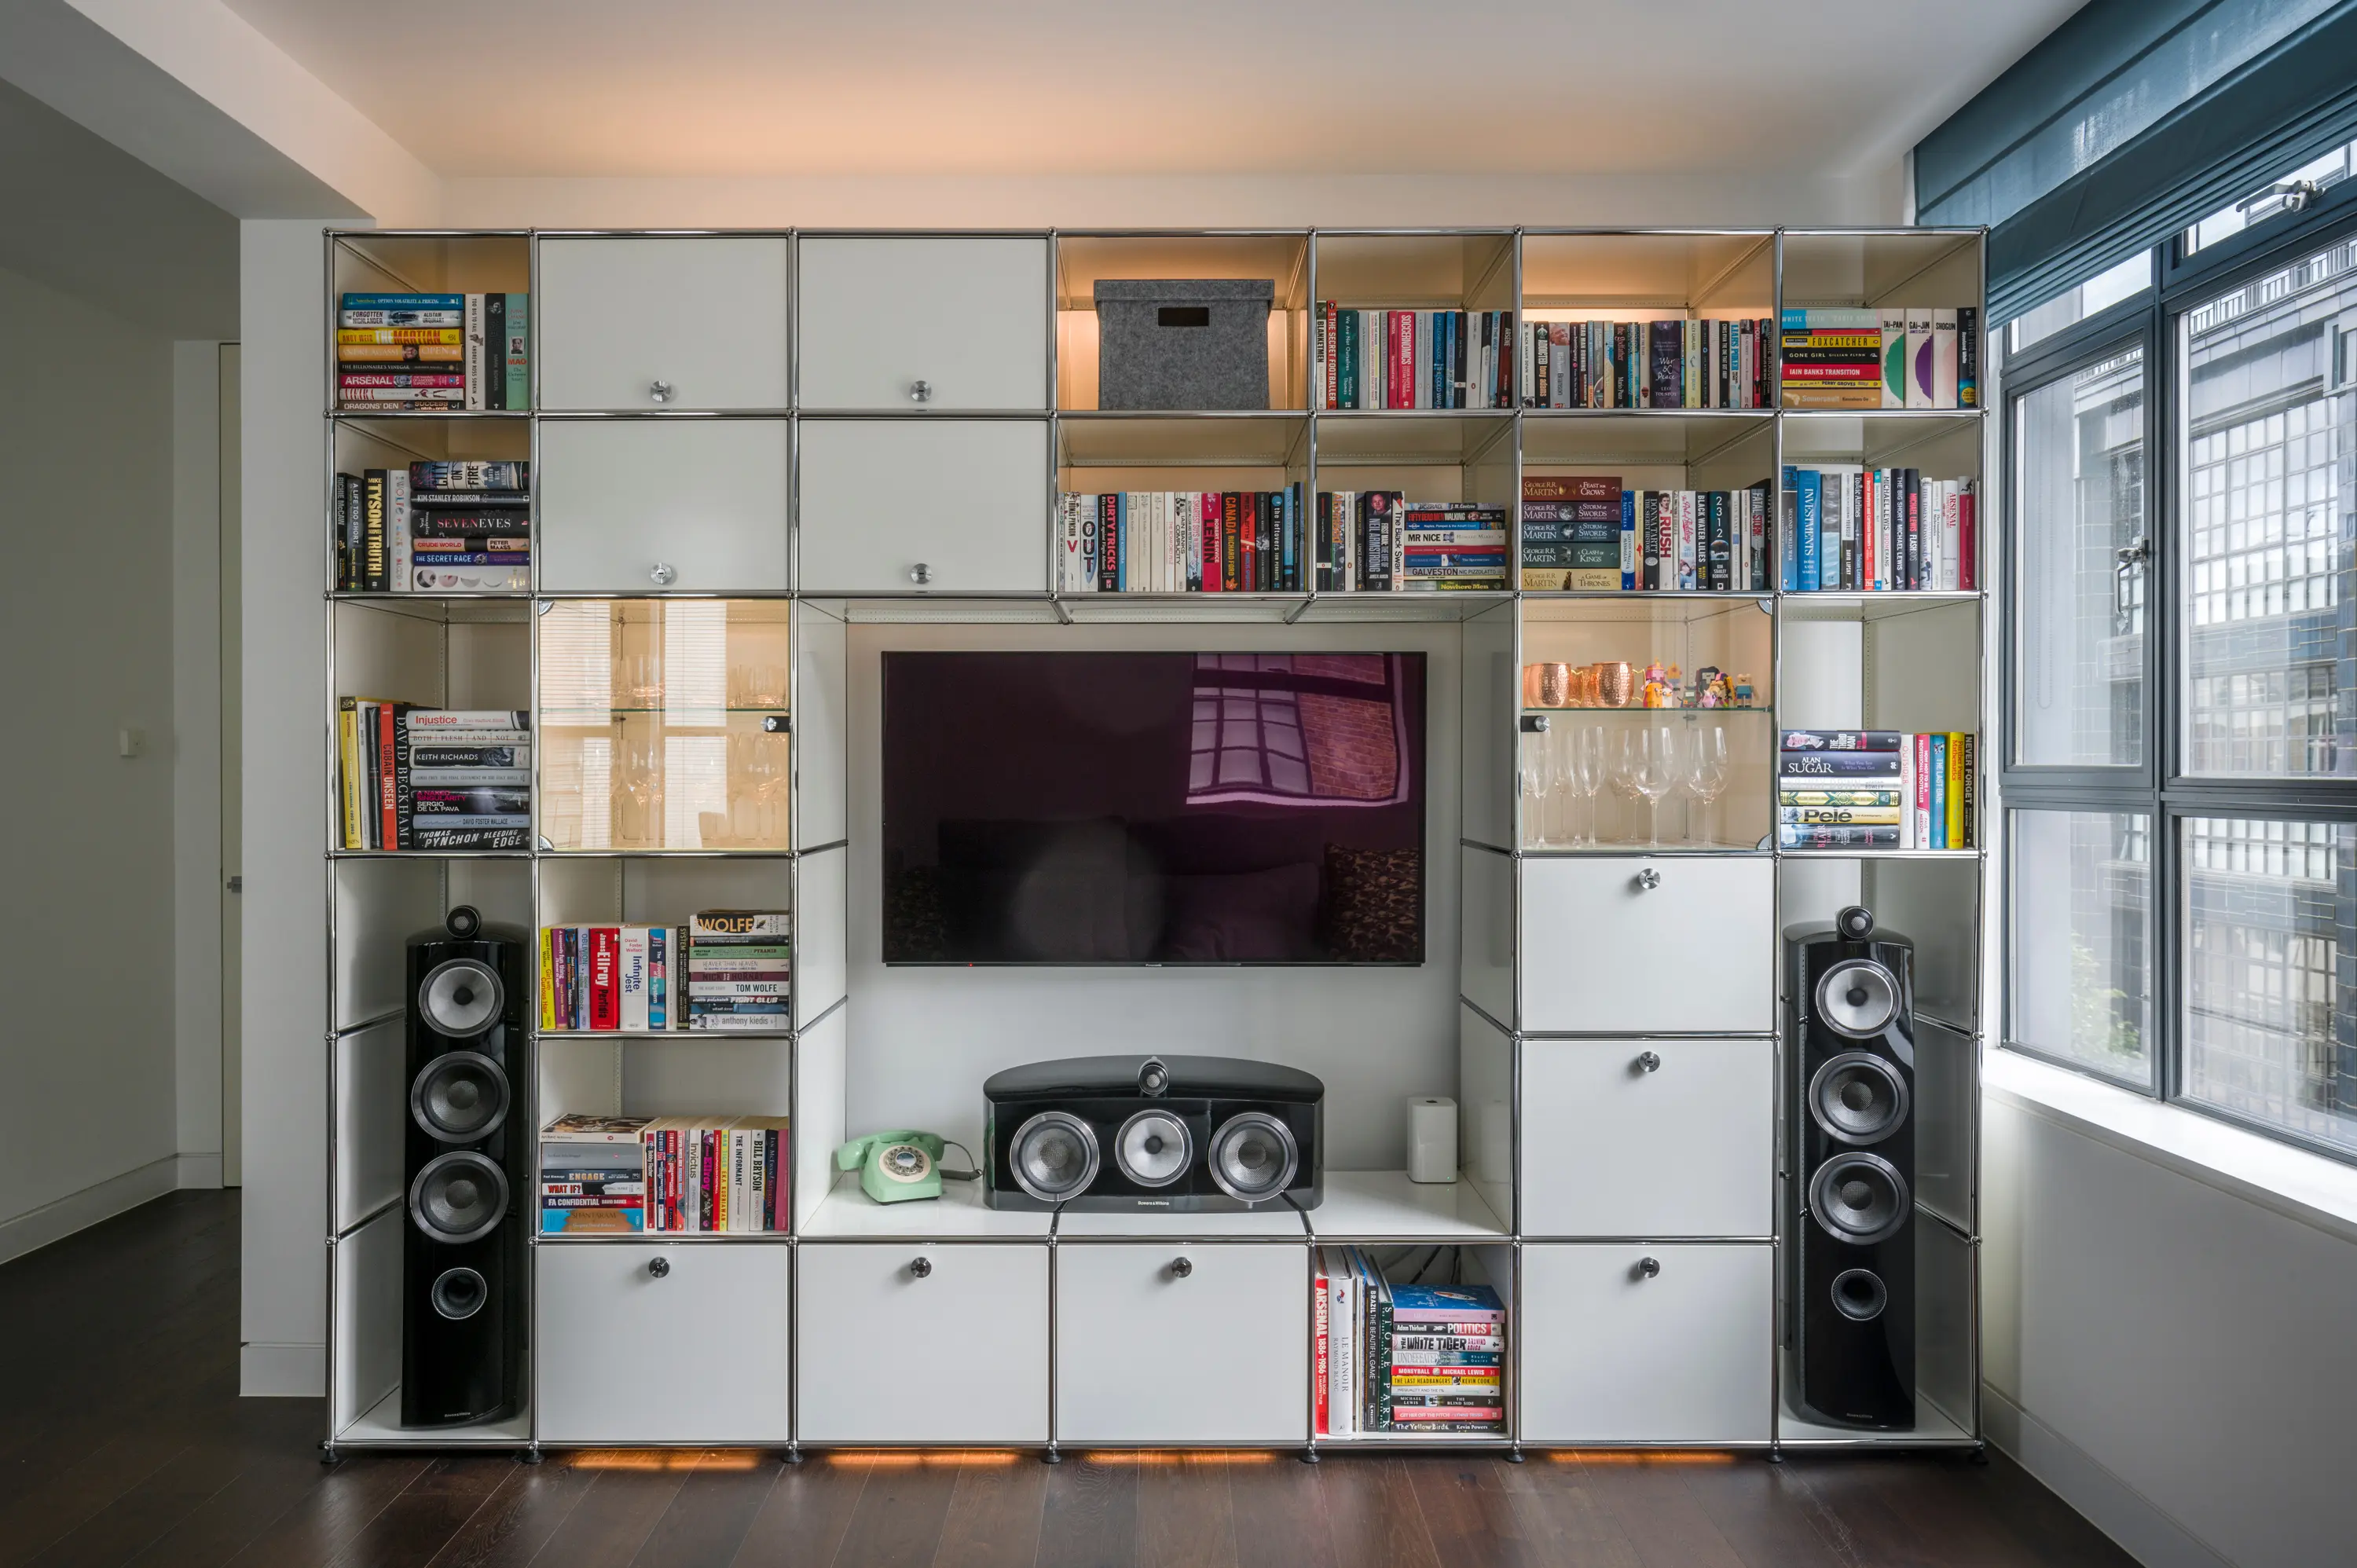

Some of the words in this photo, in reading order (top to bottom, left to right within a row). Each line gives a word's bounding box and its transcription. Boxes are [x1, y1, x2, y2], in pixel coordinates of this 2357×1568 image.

[1346, 316, 1351, 324] We
[376, 330, 394, 345] THE
[394, 330, 441, 345] MARTIAN
[1402, 315, 1412, 365] SOCCERNOMICS
[1813, 338, 1868, 346] FOXCATCHER
[1538, 340, 1548, 365] ADDICTED
[1662, 366, 1671, 375] &
[1524, 488, 1557, 496] MARTIN
[368, 484, 382, 528] TYSON
[1107, 496, 1116, 531] DIRTY
[1226, 496, 1236, 534] CANADA
[1805, 489, 1814, 556] INVESTMENTS
[438, 518, 511, 529] SEVENEVES
[1369, 518, 1380, 532] NEIL
[1204, 519, 1215, 563] LENIN
[1660, 516, 1671, 559] RUSH
[1067, 540, 1078, 553] V
[1107, 533, 1116, 571] TRICKS
[1369, 533, 1380, 572] ARMSTRONG
[416, 716, 457, 725] Injustice
[397, 716, 408, 760] DAVID
[1838, 734, 1847, 749] THIRD
[1847, 736, 1856, 749] MAN
[383, 744, 393, 775] COBAIN
[1788, 763, 1834, 774] SUGAR
[384, 777, 394, 811] UNSEEN
[398, 767, 409, 837] BECKHAM
[1804, 809, 1853, 822] Pelé
[420, 830, 451, 839] THOMAS
[425, 833, 480, 848] PYNCHON
[483, 830, 519, 839] BLEEDING
[493, 836, 522, 848] EDGE
[699, 918, 753, 932] WOLFE
[596, 952, 610, 987] Ellroy
[633, 956, 642, 991] Infinite
[722, 1017, 748, 1026] anthony
[750, 1016, 769, 1024] kiedis
[753, 1141, 763, 1159] BILL
[690, 1143, 698, 1178] Invictus
[753, 1161, 763, 1192] BRYSON
[548, 1185, 568, 1194] WHAT
[570, 1185, 581, 1194] IF?
[1316, 1288, 1328, 1337] ARSENAL
[1447, 1323, 1487, 1335] POLITICS
[1342, 1338, 1349, 1348] LE
[1407, 1337, 1434, 1351] WHITE
[1437, 1337, 1468, 1351] TIGER
[1318, 1339, 1327, 1374] 1886-1986
